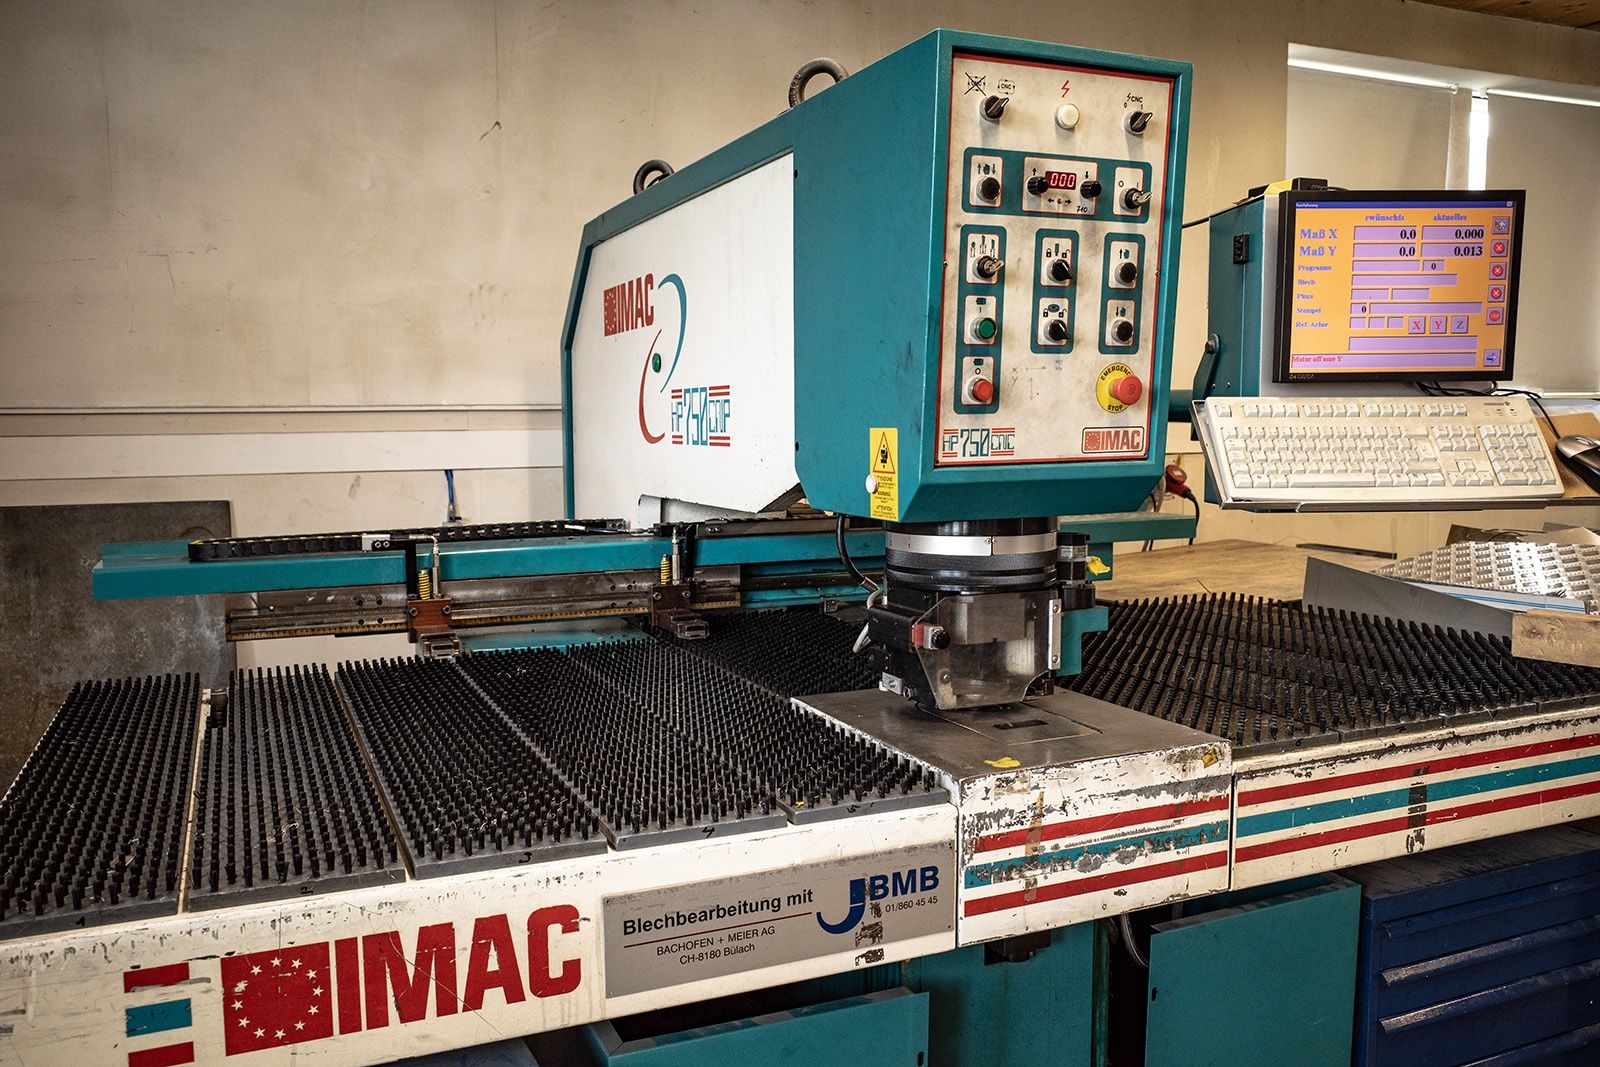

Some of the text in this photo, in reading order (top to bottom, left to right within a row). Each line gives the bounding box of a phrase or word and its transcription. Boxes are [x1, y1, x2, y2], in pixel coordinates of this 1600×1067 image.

[1050, 173, 1076, 187] 000
[1300, 229, 1337, 239] Maß X
[1400, 229, 1417, 240] 0.0
[1455, 229, 1484, 240] 0.000
[1299, 246, 1337, 256] Maß Y
[1399, 247, 1416, 257] 0.0
[1453, 246, 1483, 257] 0.013
[1430, 262, 1437, 270] 0
[617, 273, 655, 334] IMAC
[1361, 305, 1367, 313] 0
[1413, 320, 1421, 330] X
[1434, 320, 1443, 329] Y
[1456, 320, 1464, 329] Z
[1107, 404, 1123, 412] STOP
[1101, 430, 1141, 450] IMAC
[702, 826, 716, 839] 4
[869, 865, 940, 901] BMB
[885, 900, 914, 913] 01/860
[915, 898, 926, 907] 45
[927, 895, 938, 905] 45
[622, 889, 814, 936] Blechbearbeitung mit
[656, 926, 776, 956] BACHOFEN + MEIER AG
[679, 942, 756, 965] CH-8180 Bülach
[335, 904, 581, 1035] IMAC
